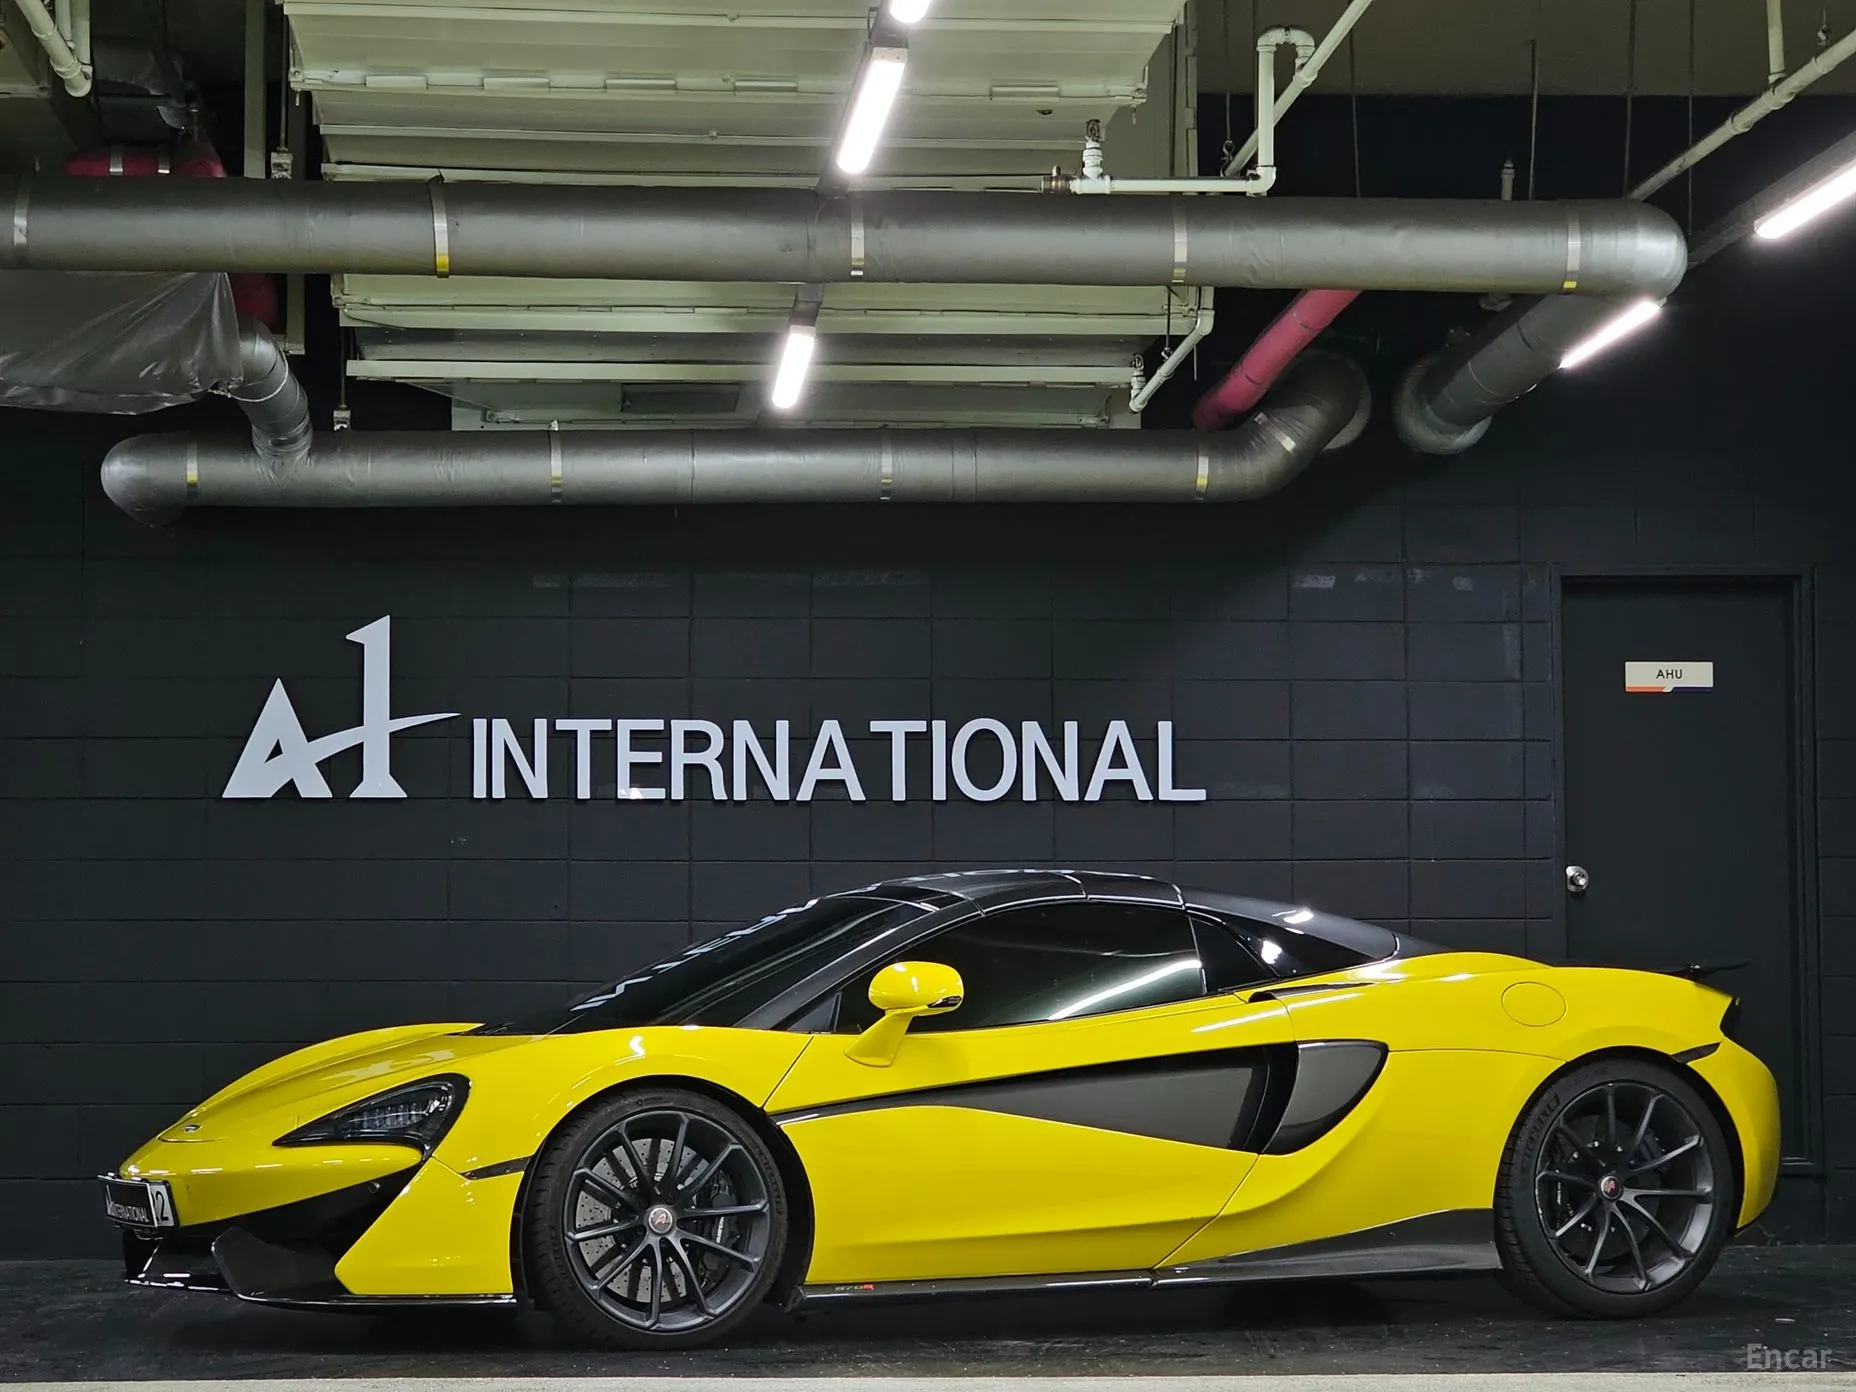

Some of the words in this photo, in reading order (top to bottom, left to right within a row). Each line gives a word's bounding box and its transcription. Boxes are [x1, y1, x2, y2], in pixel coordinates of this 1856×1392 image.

[1656, 669, 1683, 679] AHU
[222, 614, 459, 800] A1
[473, 718, 1207, 803] INTERNATIONAL
[151, 1190, 169, 1221] 2
